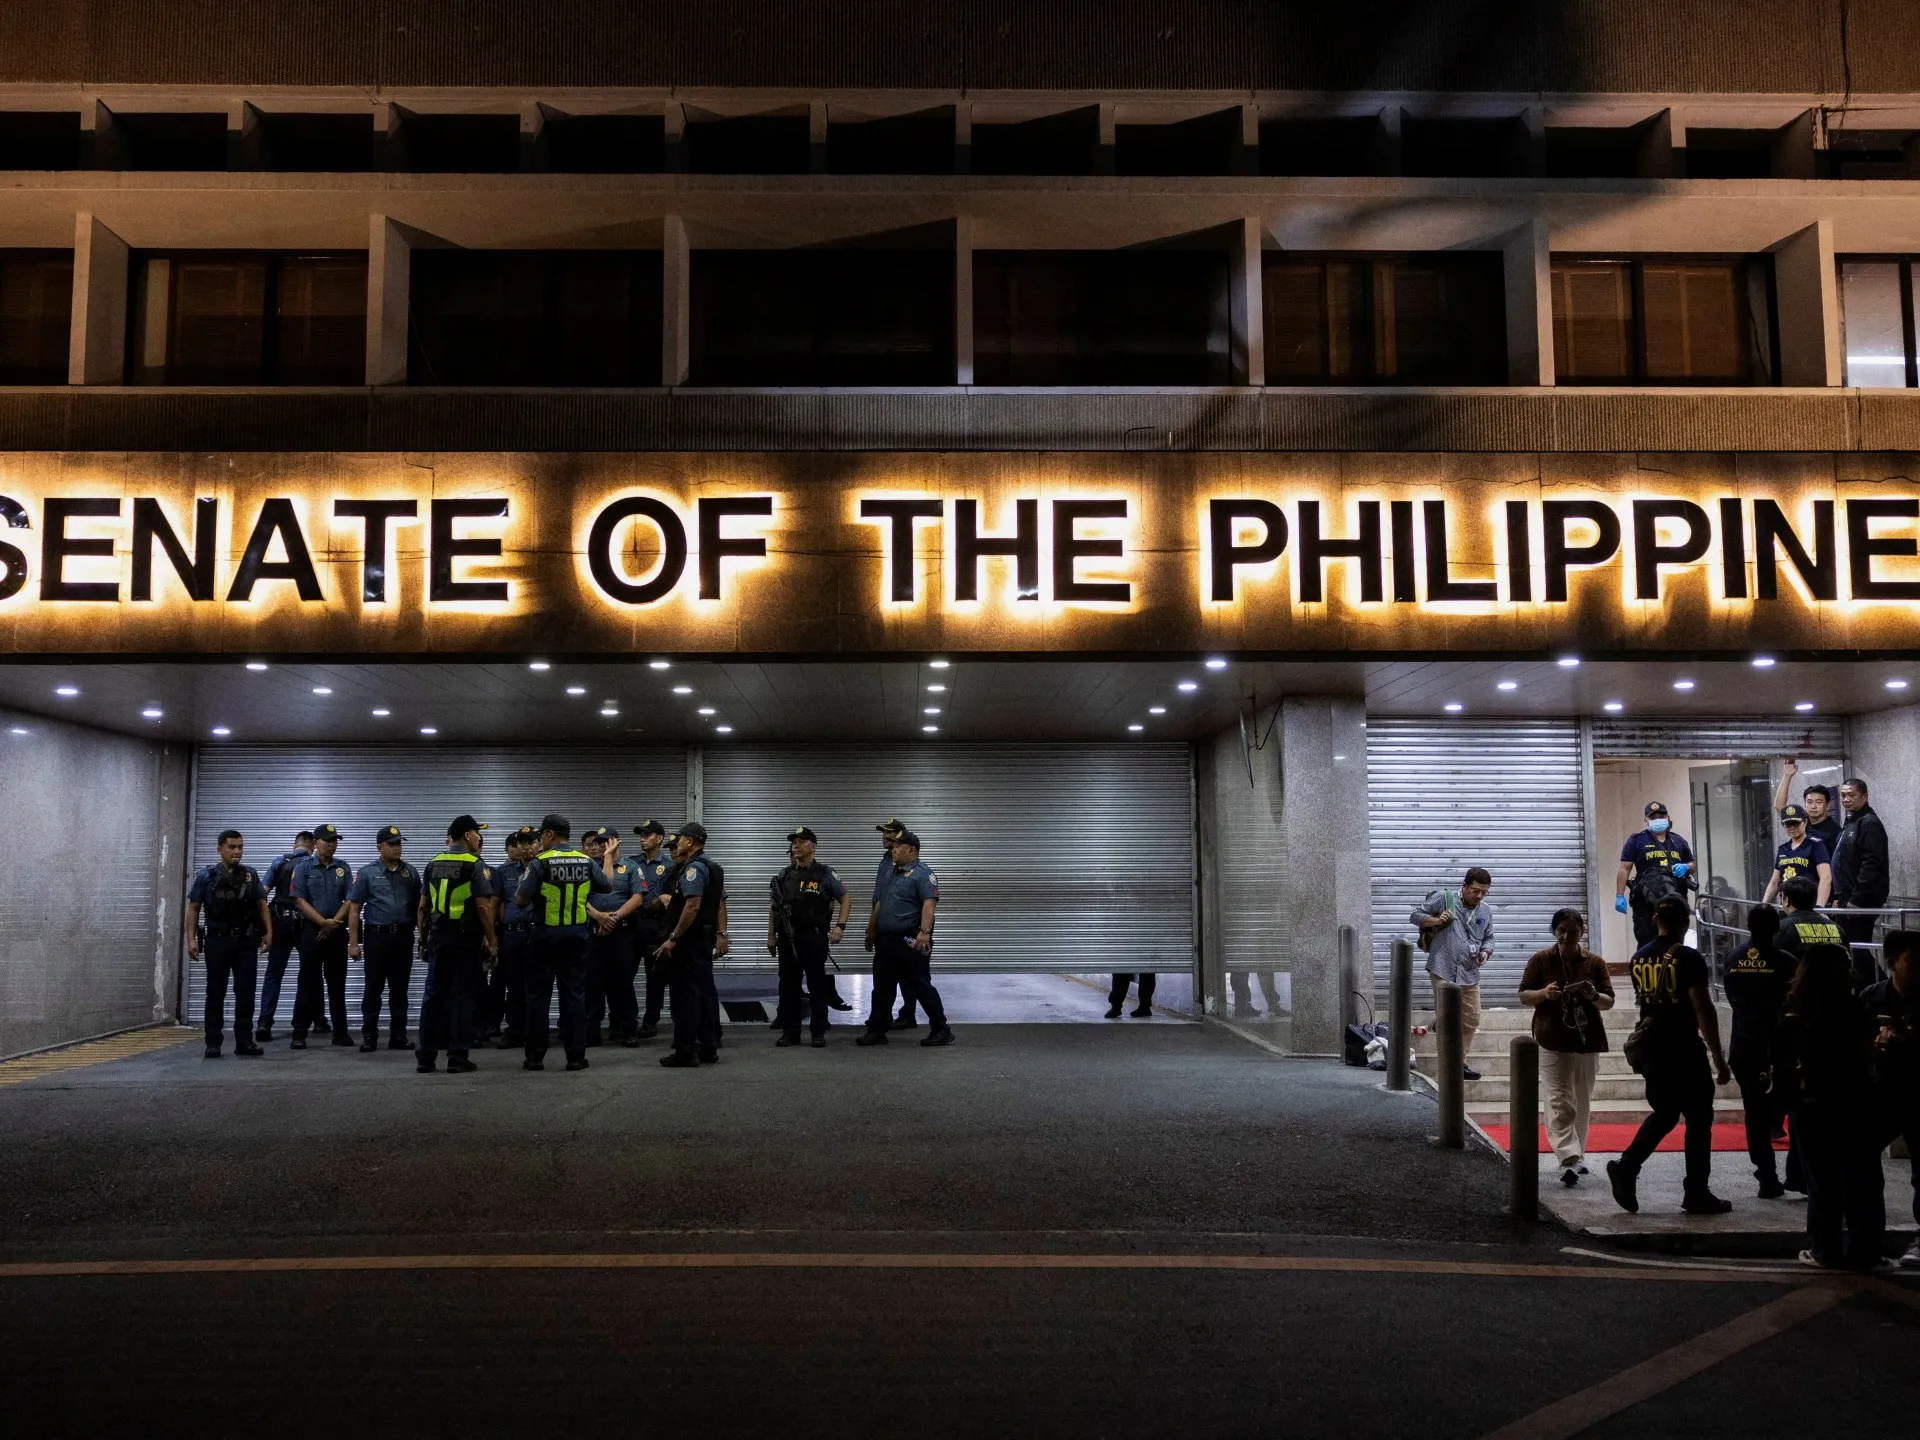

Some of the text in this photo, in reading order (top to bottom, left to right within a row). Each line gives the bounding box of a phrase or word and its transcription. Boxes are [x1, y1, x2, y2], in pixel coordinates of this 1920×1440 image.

[588, 496, 773, 604] OF
[860, 499, 1131, 602] THE
[551, 866, 589, 881] POLICE
[1633, 957, 1679, 966] POLIE
[1737, 959, 1767, 968] SOCO
